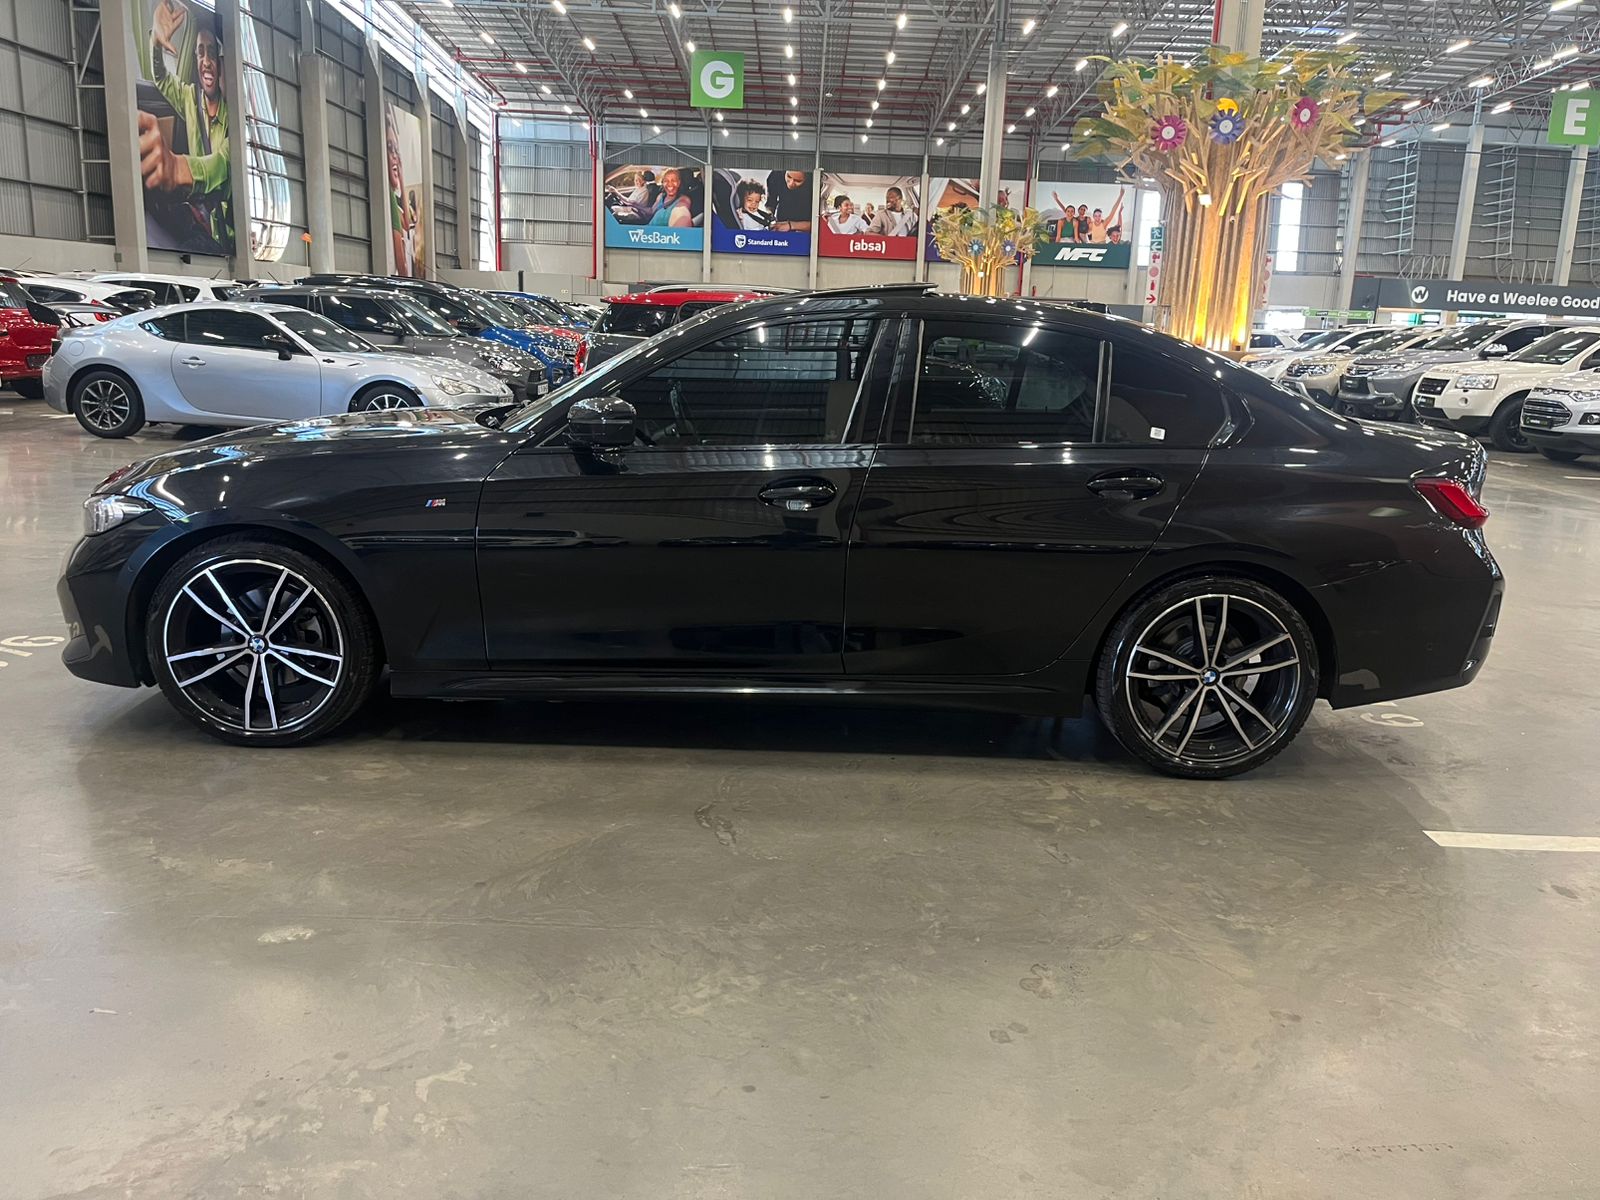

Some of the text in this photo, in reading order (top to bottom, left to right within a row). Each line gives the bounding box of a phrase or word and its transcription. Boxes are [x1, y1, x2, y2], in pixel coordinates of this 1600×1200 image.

[700, 60, 735, 99] G
[1563, 98, 1590, 136] E
[628, 229, 681, 245] WesBank
[747, 238, 789, 247] Standard Bank
[1054, 247, 1107, 262] MFC
[1447, 289, 1487, 303] Have
[1489, 294, 1500, 304] a
[1503, 292, 1558, 307] Weelee
[1561, 295, 1600, 309] Good
